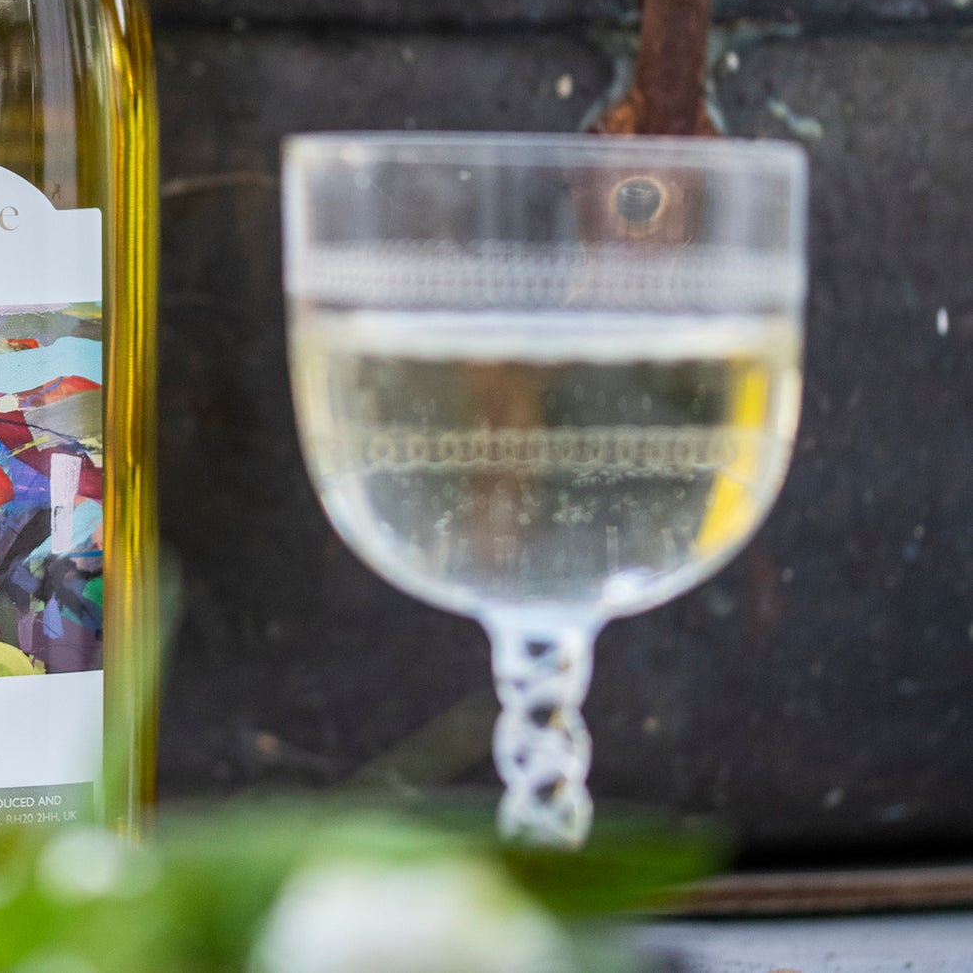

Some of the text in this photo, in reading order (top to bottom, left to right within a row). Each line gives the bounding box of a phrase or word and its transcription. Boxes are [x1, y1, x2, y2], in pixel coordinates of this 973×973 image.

[38, 795, 62, 807] AND
[6, 813, 34, 825] RH20
[63, 811, 77, 821] UK
